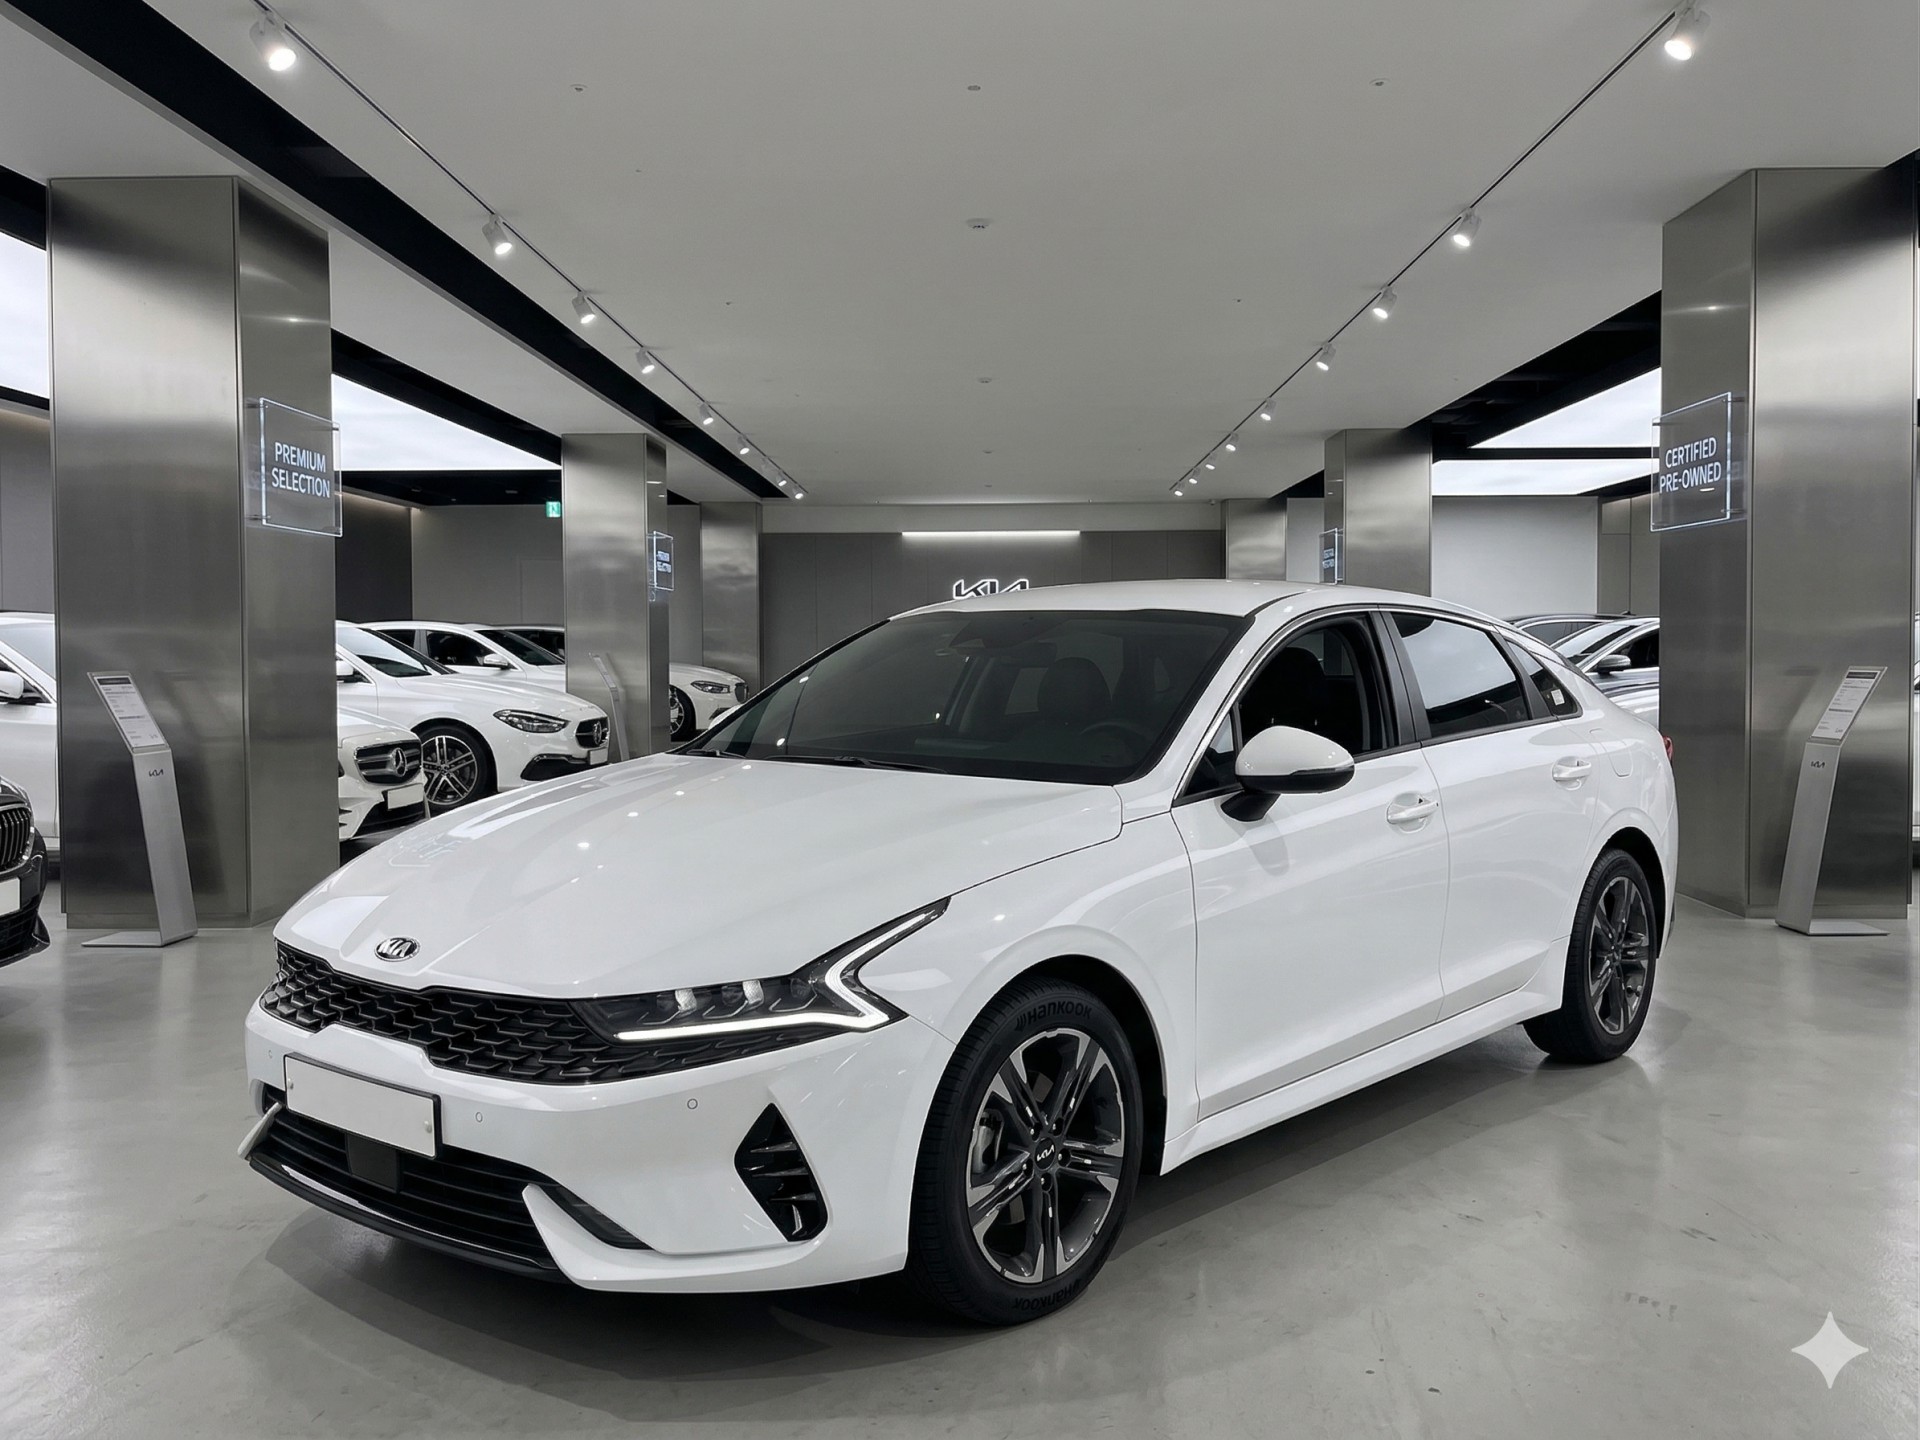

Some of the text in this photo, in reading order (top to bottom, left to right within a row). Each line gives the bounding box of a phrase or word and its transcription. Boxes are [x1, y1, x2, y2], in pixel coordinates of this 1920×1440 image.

[274, 442, 327, 473] PREMIUM
[1665, 437, 1717, 468] CERTIFIED
[271, 468, 331, 498] SELECTION
[1659, 462, 1722, 494] PRE-OWNED
[952, 578, 1030, 600] KIA
[377, 938, 414, 958] KIA
